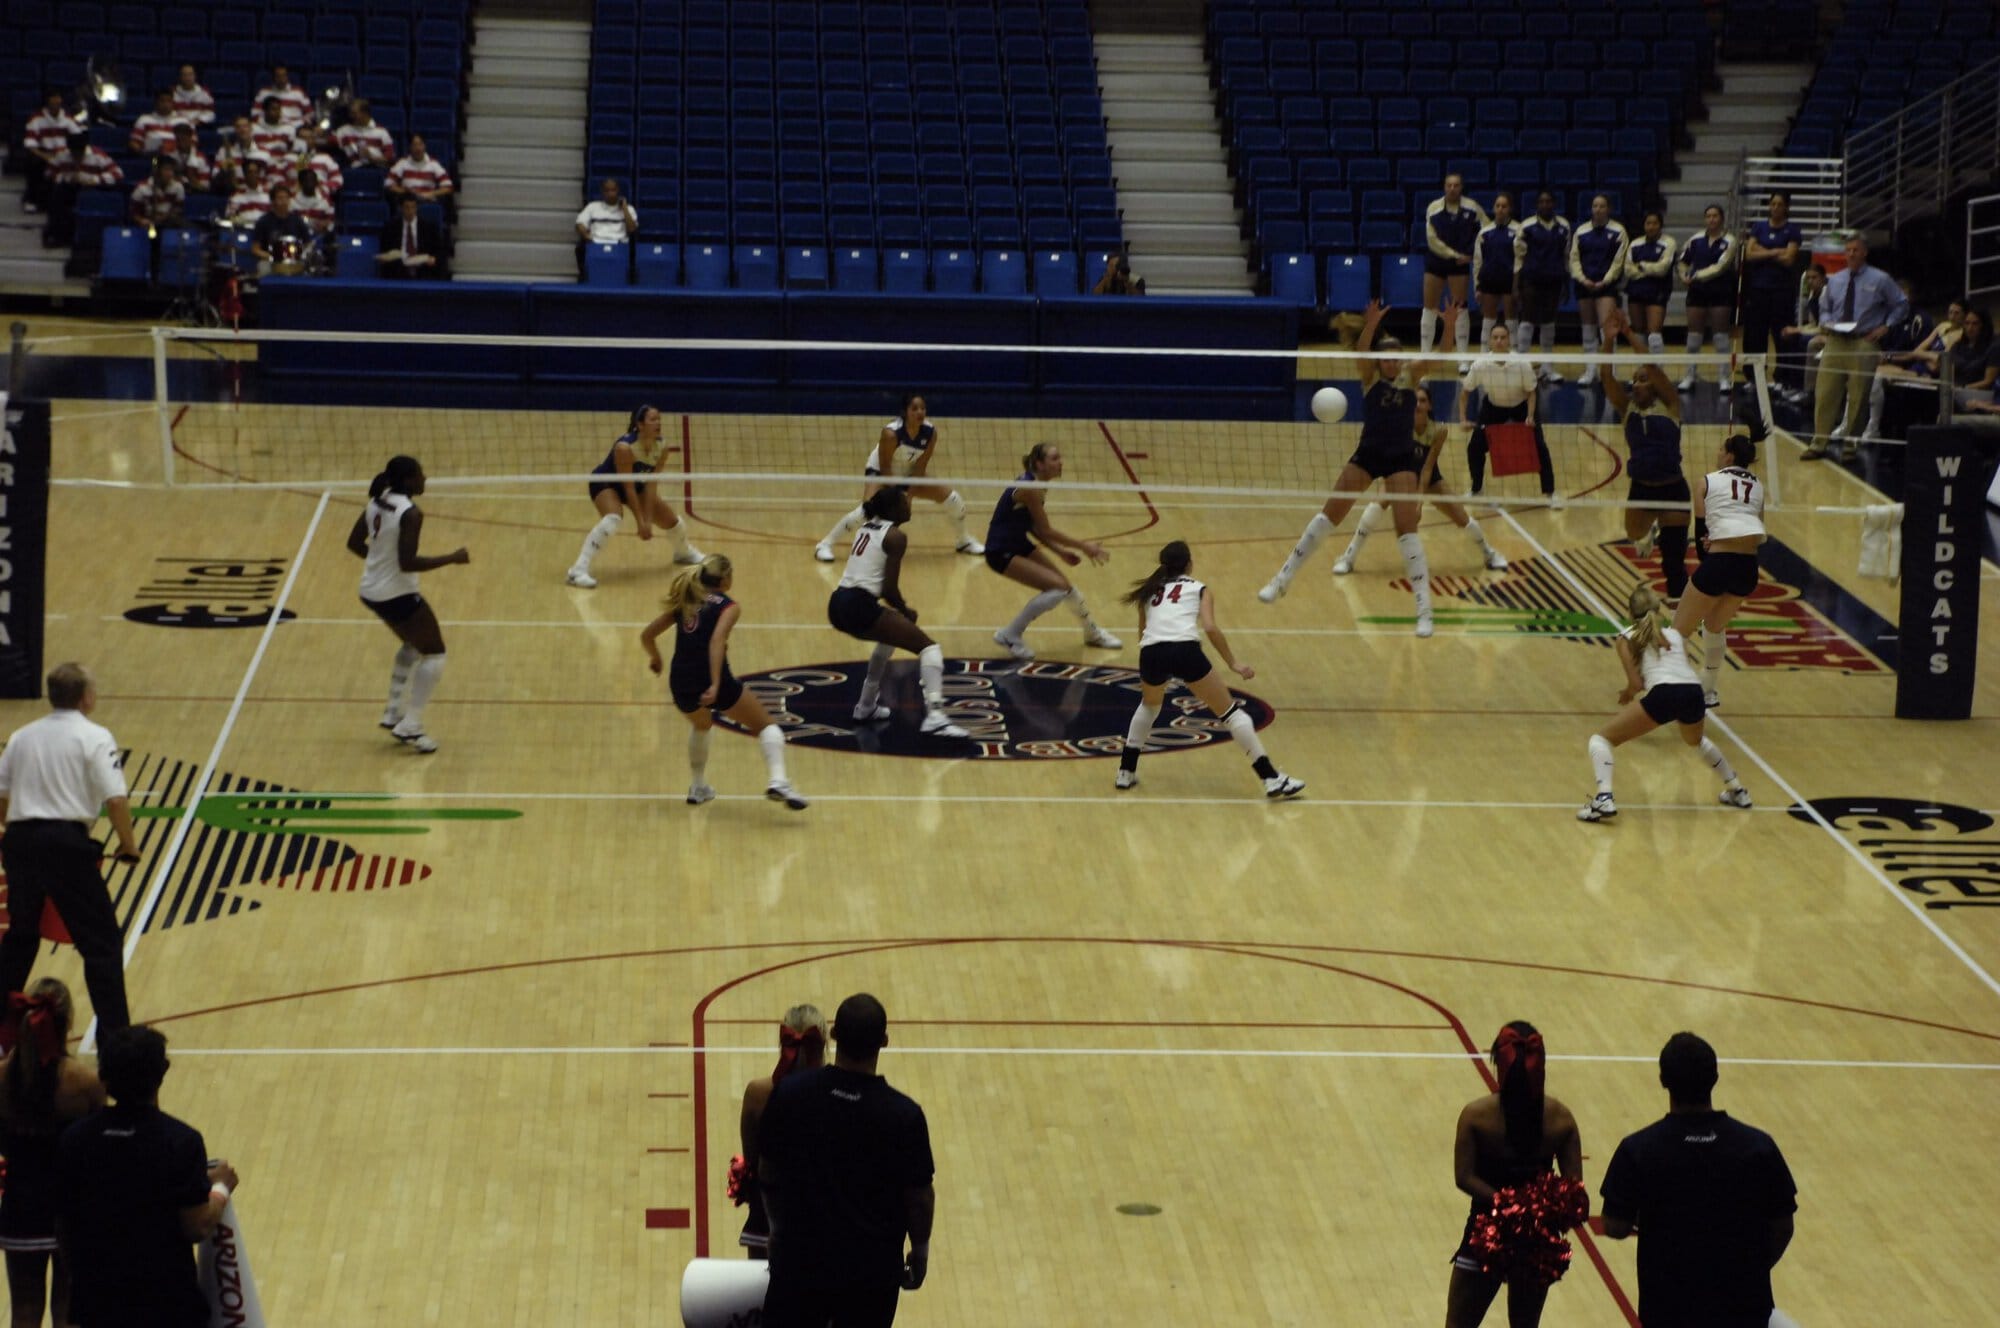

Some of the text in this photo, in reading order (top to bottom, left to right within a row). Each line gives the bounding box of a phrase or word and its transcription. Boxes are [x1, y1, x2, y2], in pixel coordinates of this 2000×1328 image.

[1731, 479, 1754, 504] 17
[851, 532, 871, 556] 10
[1929, 456, 1962, 675] WILDCATS
